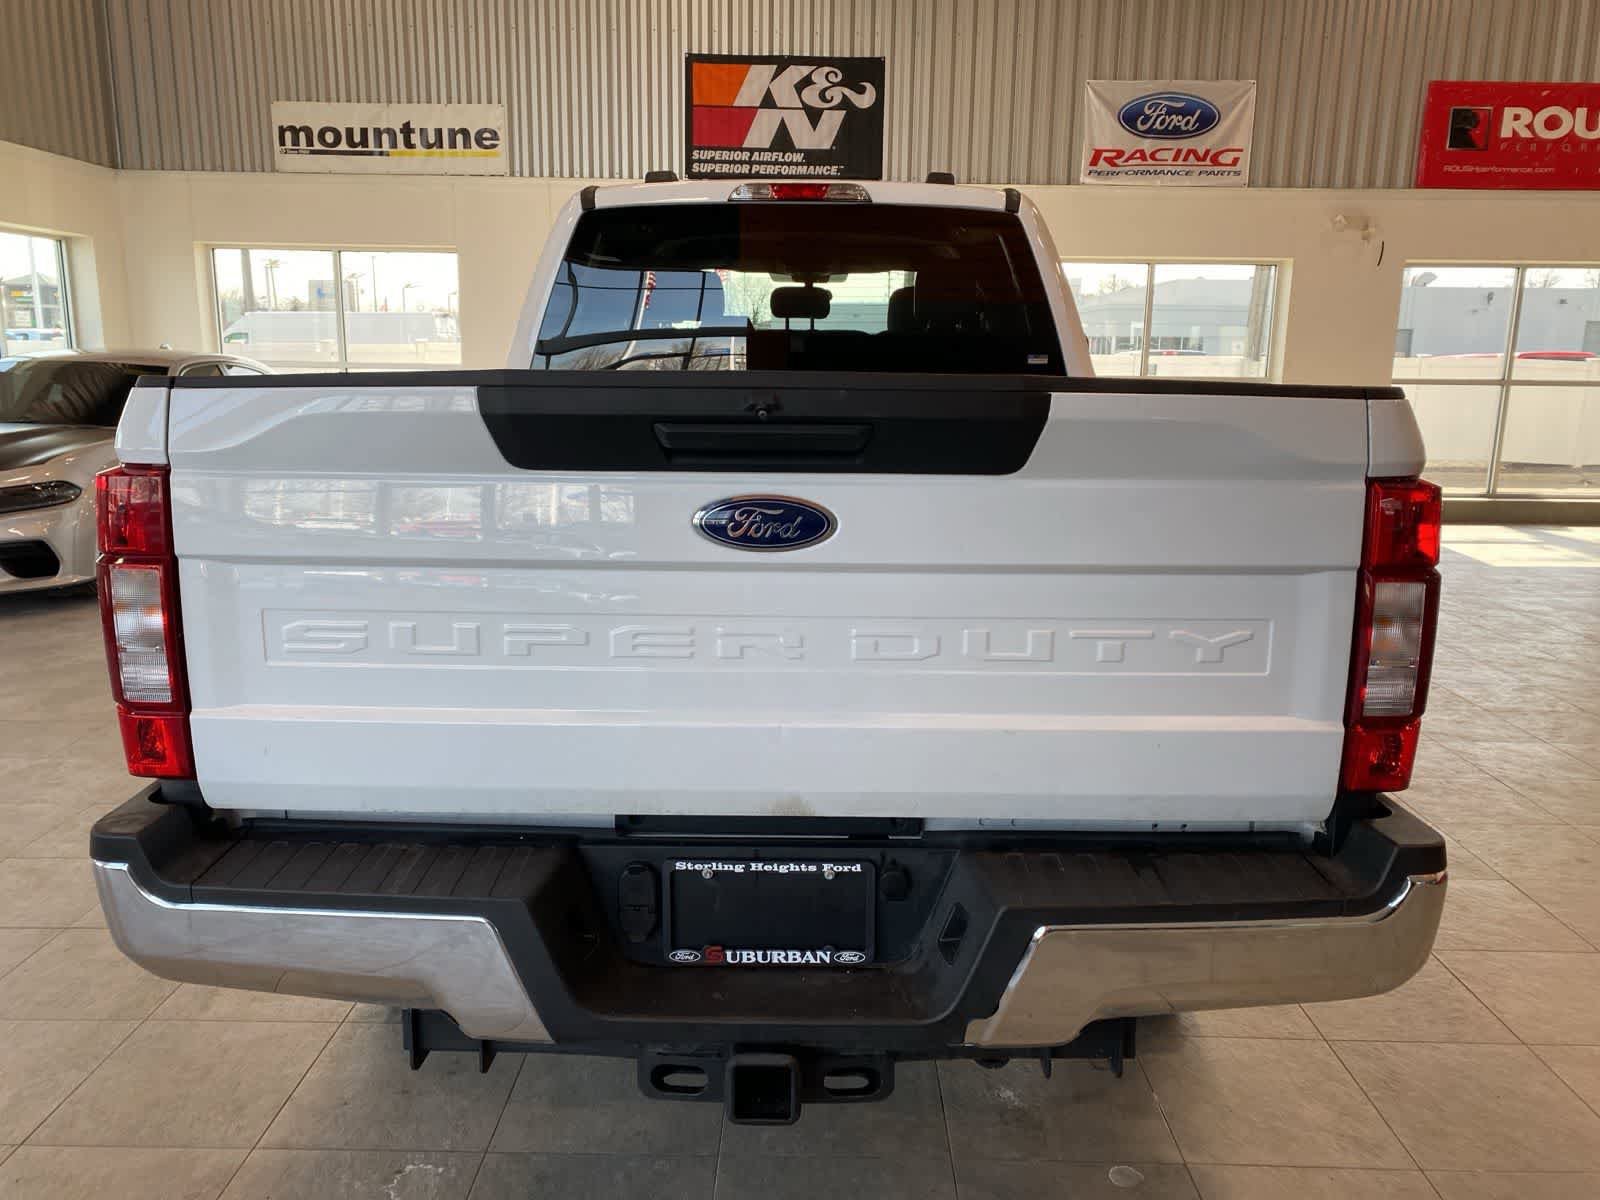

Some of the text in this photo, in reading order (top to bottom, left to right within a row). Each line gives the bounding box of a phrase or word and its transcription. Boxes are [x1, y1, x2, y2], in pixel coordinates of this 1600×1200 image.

[733, 64, 876, 149] K&N
[1137, 100, 1201, 131] Ford
[278, 120, 500, 150] mountune
[692, 150, 805, 163] SUPERIOR AIRFLOW.
[1088, 147, 1244, 168] RACING
[1501, 142, 1600, 153] PERFOR
[692, 162, 750, 174] SUPERIOR
[1088, 169, 1195, 177] PERFORMANCE
[727, 506, 802, 538] Ford
[282, 620, 1254, 664] SUPER DUTY
[675, 861, 862, 873] Sterling Heights Ford
